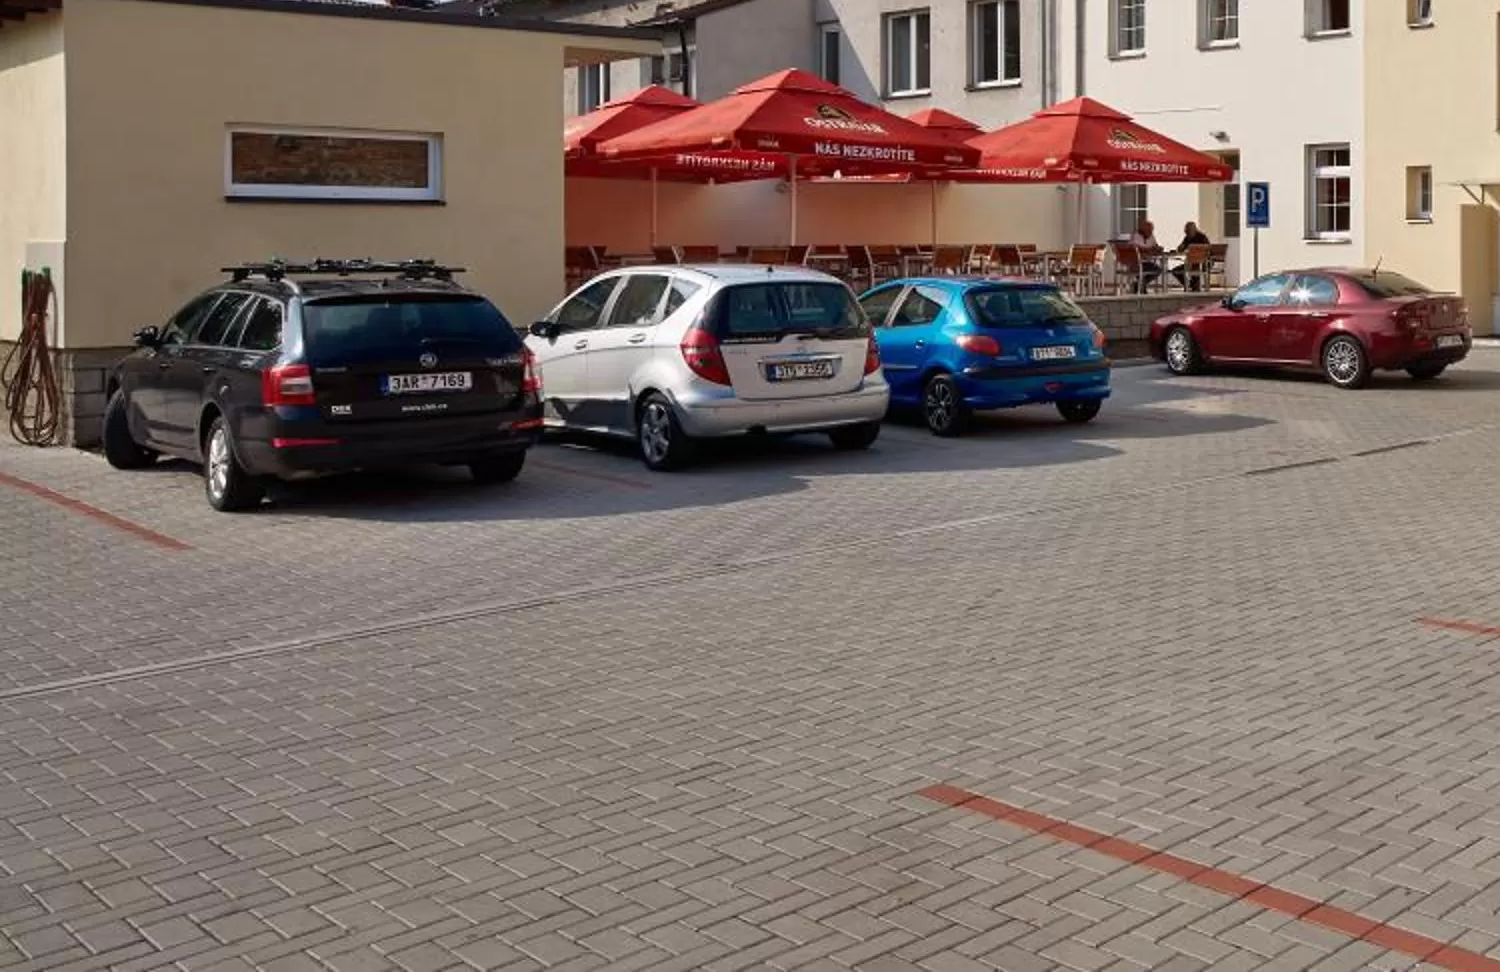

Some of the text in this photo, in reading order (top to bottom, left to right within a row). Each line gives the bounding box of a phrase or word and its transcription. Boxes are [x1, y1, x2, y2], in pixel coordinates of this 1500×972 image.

[815, 140, 916, 161] NÁS NEZKROTÍTE
[1252, 188, 1265, 212] P
[393, 373, 465, 389] 3AR 7169
